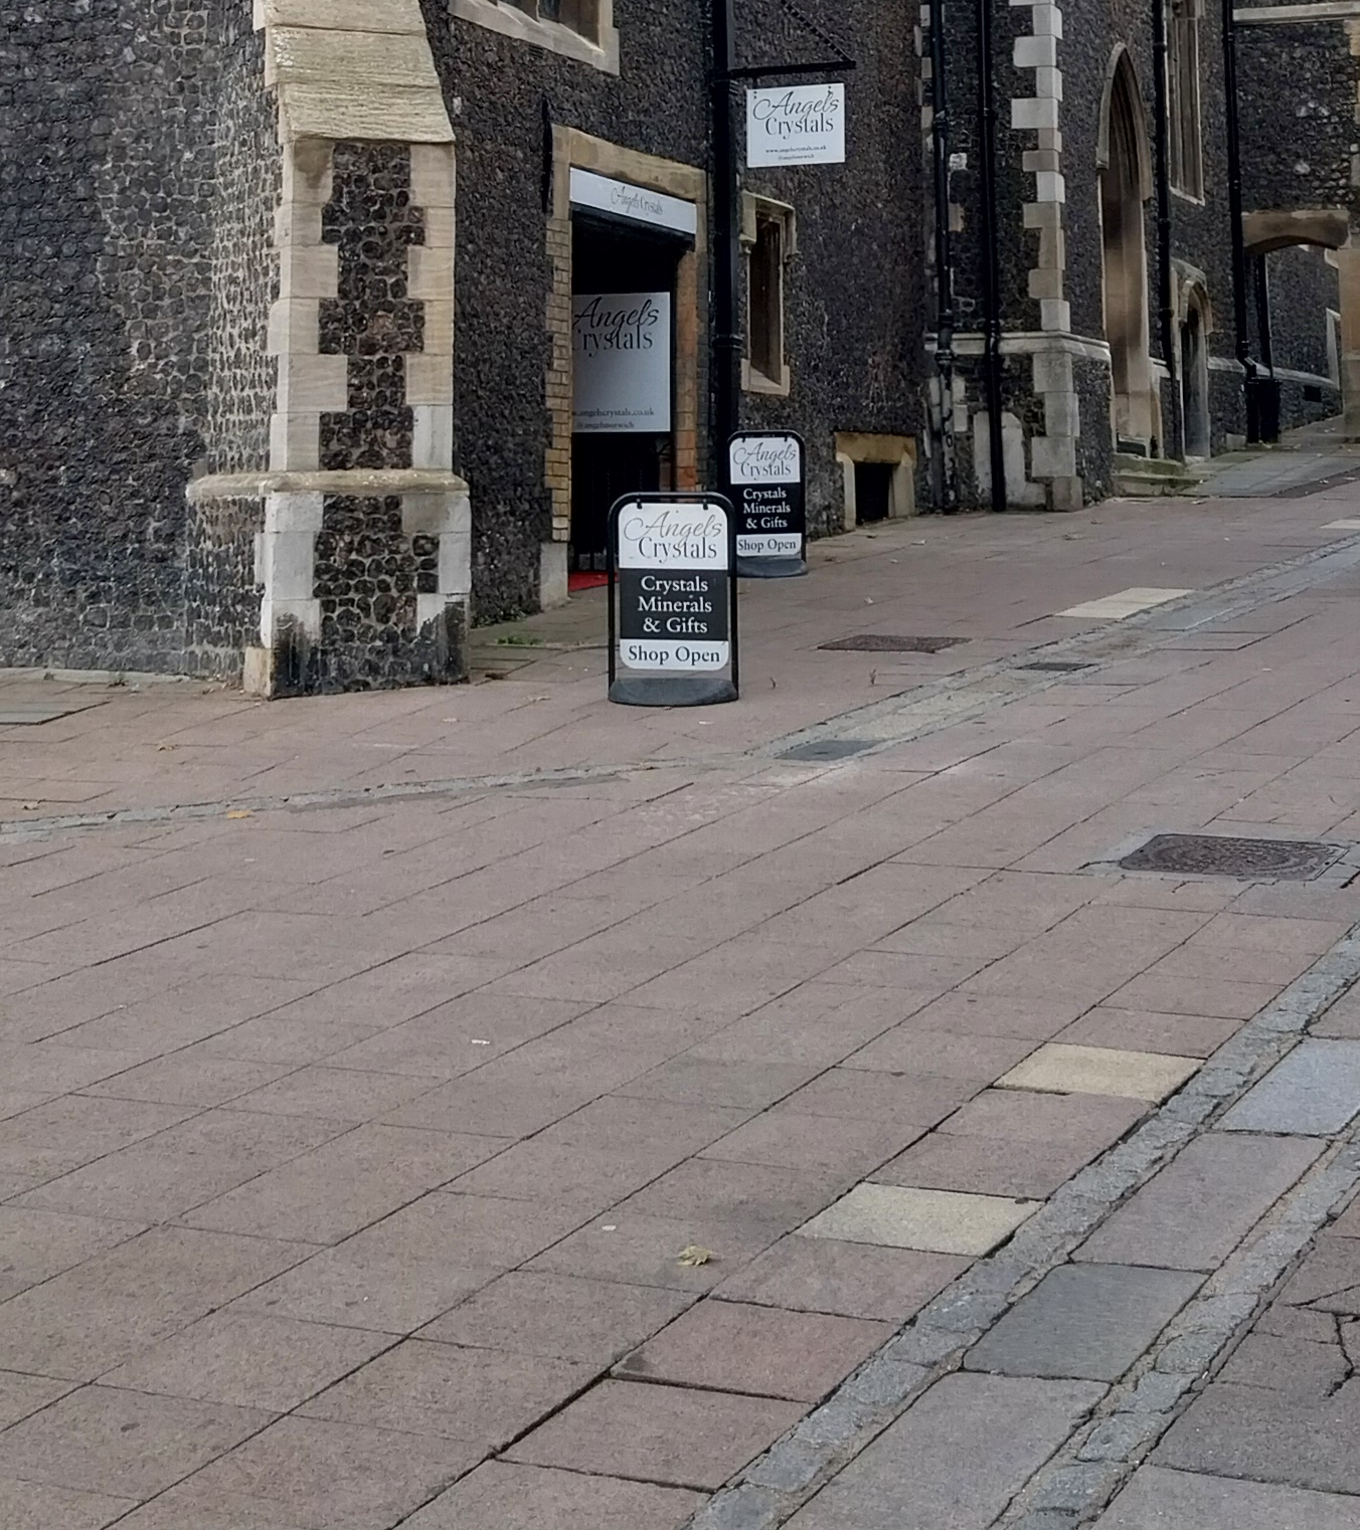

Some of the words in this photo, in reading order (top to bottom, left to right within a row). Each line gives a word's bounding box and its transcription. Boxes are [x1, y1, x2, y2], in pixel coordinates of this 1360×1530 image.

[752, 90, 840, 121] Angels
[765, 112, 834, 140] Crystals
[572, 296, 660, 334] Angels
[733, 441, 797, 466] Angels
[740, 462, 792, 481] Crystals
[743, 487, 787, 502] Crystals
[743, 501, 791, 514] Minerals
[624, 510, 723, 545] Angels
[745, 517, 758, 529] &
[760, 515, 788, 529] Gifts
[638, 537, 718, 565] Crystals
[738, 539, 765, 553] Shop
[767, 537, 797, 552] Open
[641, 575, 709, 595] Crystals
[637, 595, 713, 613] Minerals
[643, 617, 662, 633] &
[666, 616, 708, 633] Gifts
[628, 645, 670, 666] Shop
[675, 645, 721, 666] Open
